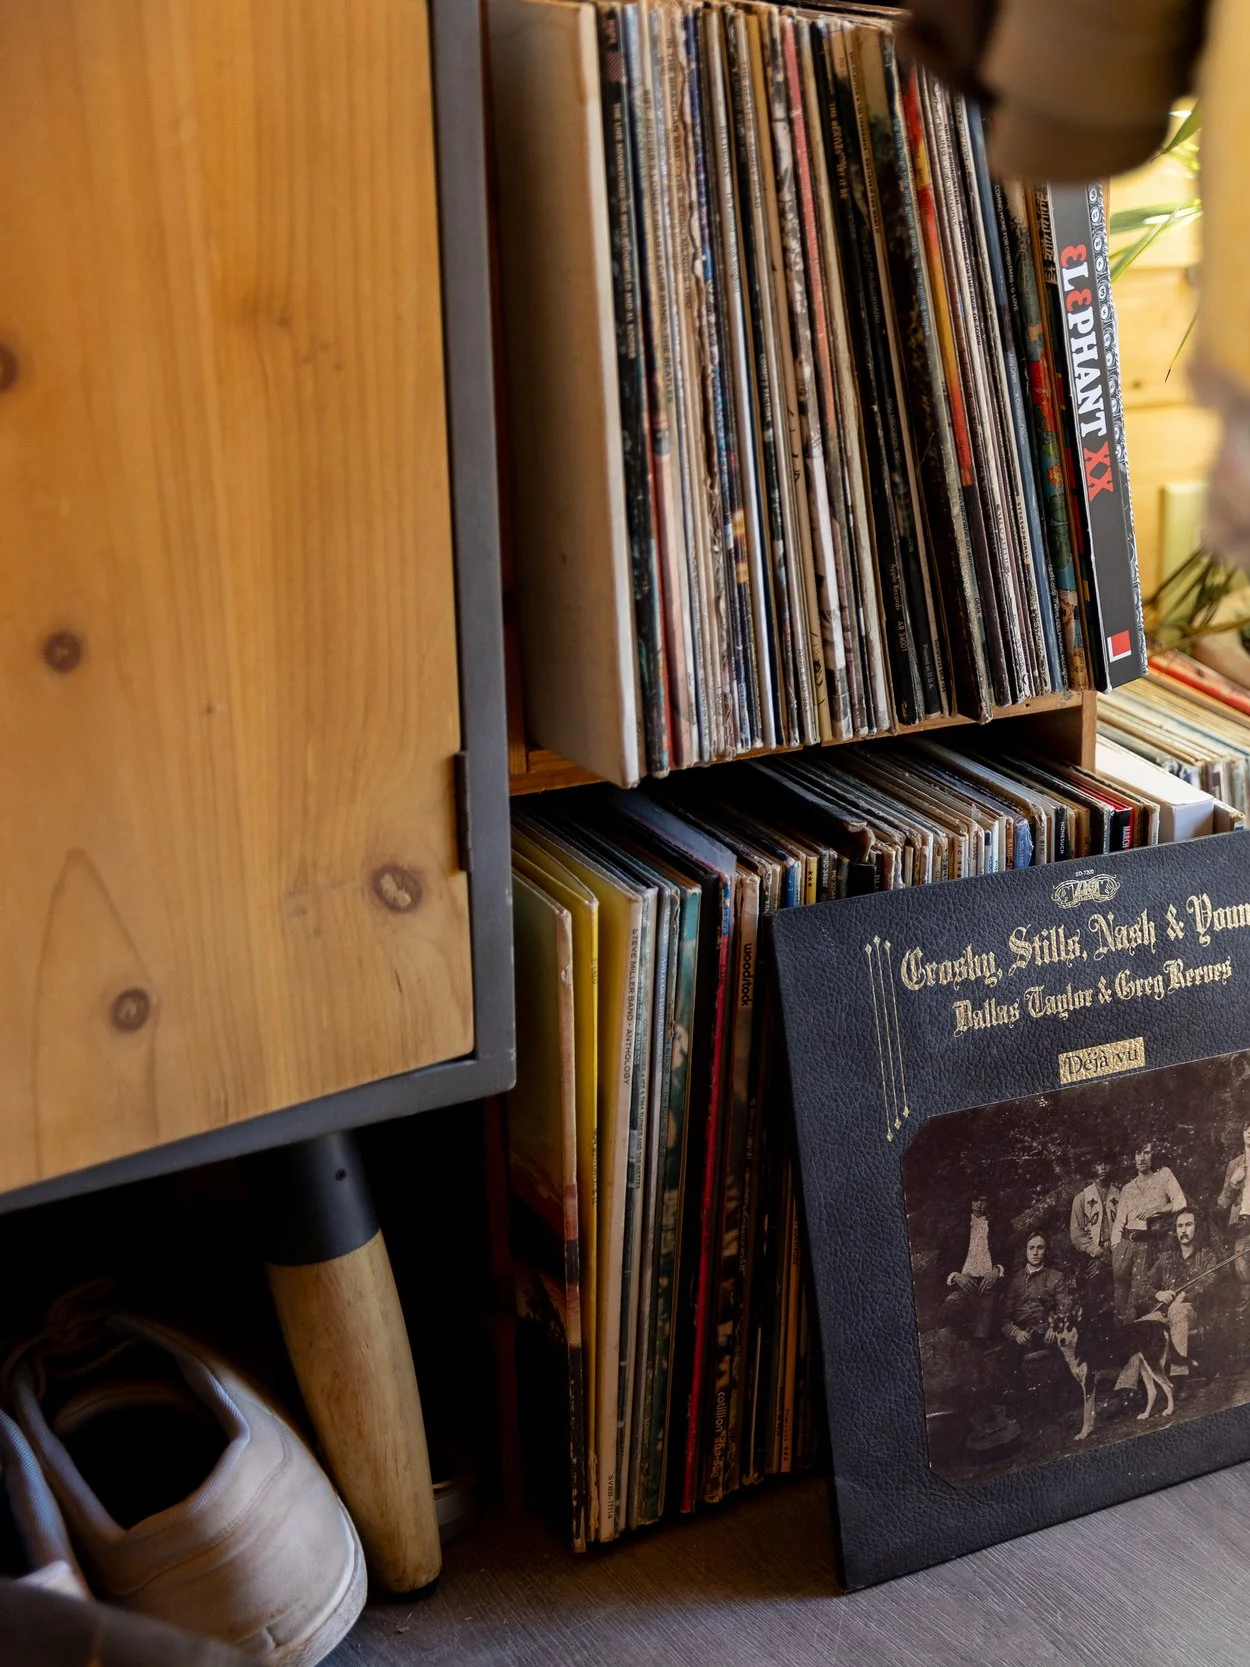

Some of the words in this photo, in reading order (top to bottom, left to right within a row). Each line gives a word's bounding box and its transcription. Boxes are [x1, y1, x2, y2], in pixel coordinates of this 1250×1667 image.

[613, 103, 621, 119] THE
[643, 89, 651, 111] SGT.
[669, 77, 678, 132] BRAZILIAN
[741, 83, 754, 130] BEATLES
[614, 122, 622, 139] LIVE
[644, 118, 656, 170] PEPPER'S
[615, 142, 627, 199] ADVENTURES
[747, 143, 757, 177] ABBEY
[649, 173, 659, 217] LONELY
[751, 180, 760, 208] ROAD
[993, 184, 1003, 211] COMING
[620, 214, 628, 233] MIKE
[677, 196, 685, 233] SERGIO
[997, 212, 1006, 231] HOME
[653, 220, 663, 260] HEARTS
[1001, 232, 1009, 244] FOR
[680, 238, 688, 280] MENDES
[1002, 246, 1015, 283] CHRISTMAS
[657, 264, 665, 291] CLUB
[624, 293, 632, 308] AND
[658, 295, 667, 323] BAND
[1010, 294, 1018, 311] LOVE
[661, 335, 669, 353] THE
[973, 324, 982, 346] TOWN
[1061, 243, 1108, 438] ELEPHANT
[1007, 352, 1015, 365] Amy
[663, 356, 674, 403] BEATLES
[1009, 367, 1017, 383] Grant
[1013, 397, 1024, 426] Christmas
[1083, 440, 1114, 502] XX
[889, 563, 899, 583] Apple
[891, 584, 902, 610] Records
[897, 620, 904, 629] AR
[897, 631, 907, 651] 34001
[920, 643, 932, 664] Printed
[796, 648, 806, 675] APPLE
[630, 928, 639, 957] STEVE
[1008, 925, 1088, 978] Stills,
[1089, 907, 1157, 962] Nash
[1166, 903, 1186, 941] &
[628, 960, 637, 993] MILLER
[740, 942, 753, 1007] woodstock
[626, 996, 635, 1020] BAND
[953, 998, 1021, 1039] Dallas
[1023, 984, 1094, 1020] Taylor
[1097, 976, 1113, 1005] &
[1114, 969, 1165, 1004] Greg
[1163, 955, 1233, 991] Reeves
[623, 1028, 633, 1085] ANTHOLOGY
[1066, 1054, 1110, 1077] Déjà
[1114, 1049, 1140, 1066] vu
[714, 1391, 726, 1432] cotillion
[604, 1475, 615, 1518] SVBB-11114
